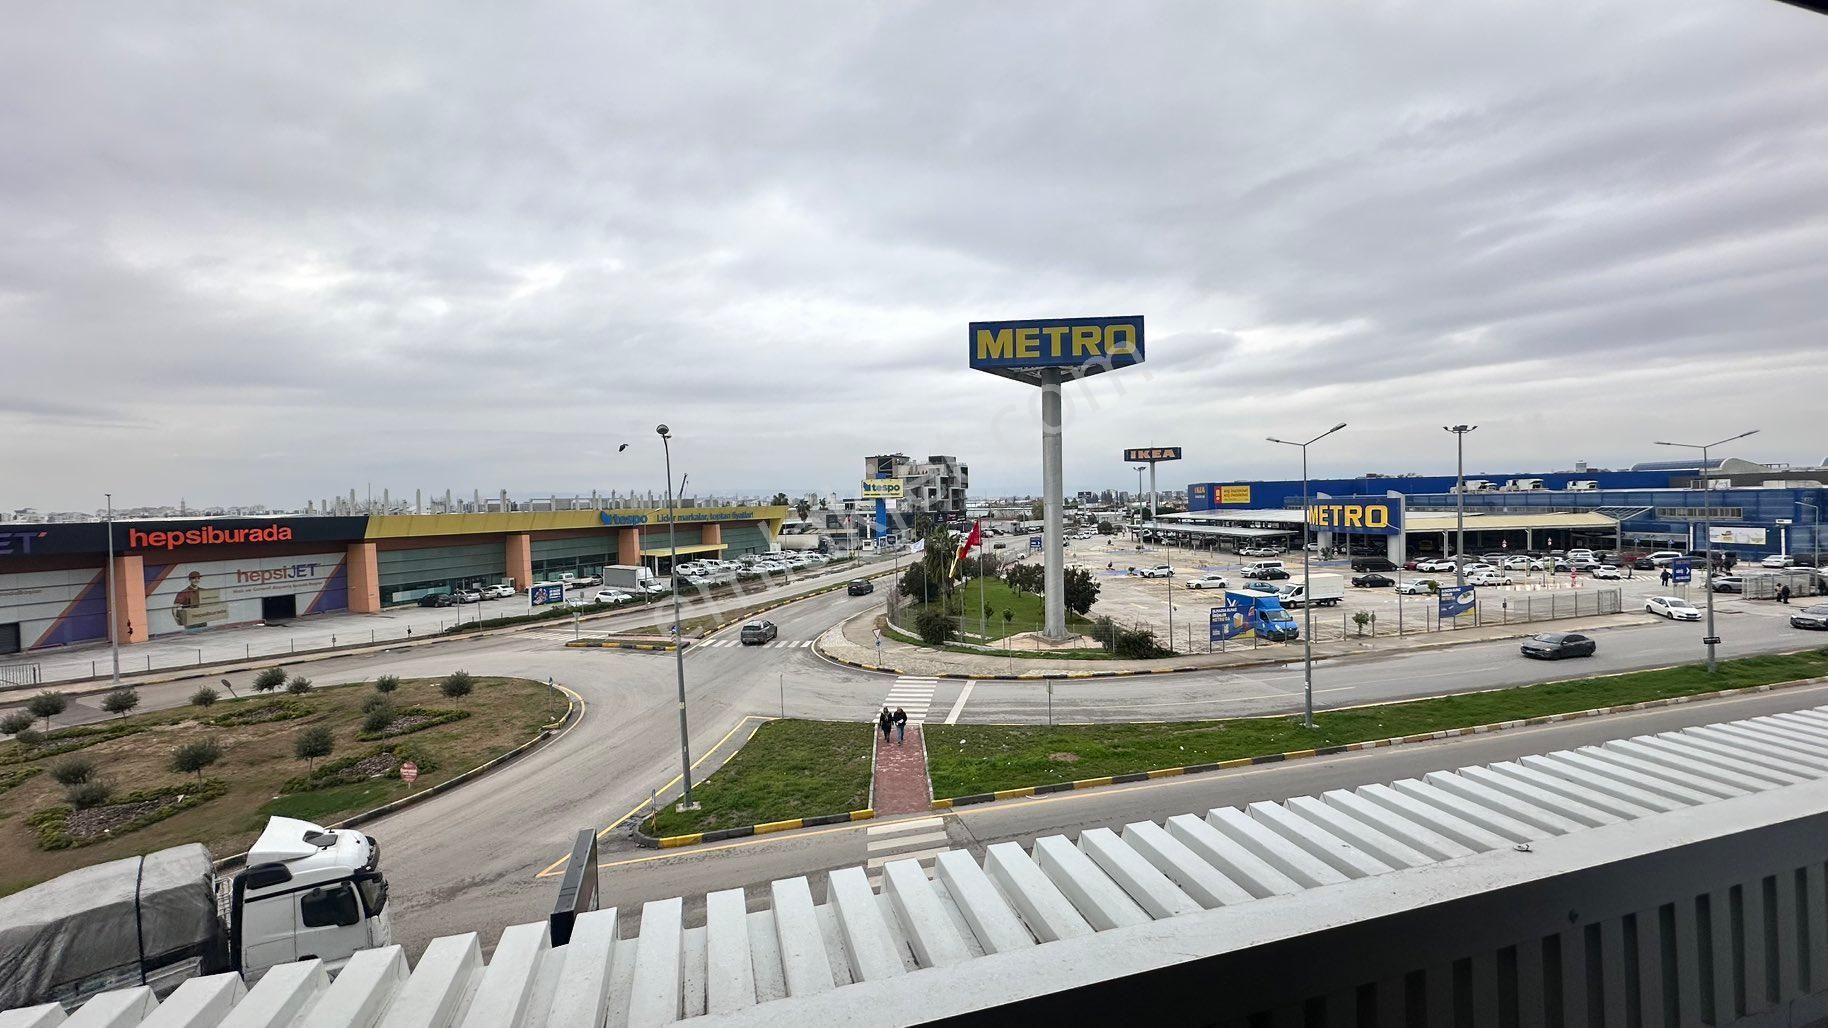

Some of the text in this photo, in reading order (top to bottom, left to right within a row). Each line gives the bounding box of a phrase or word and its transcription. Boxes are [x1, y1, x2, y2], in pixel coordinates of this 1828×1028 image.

[976, 324, 1136, 360] METRO
[1130, 448, 1177, 460] IKEA
[872, 484, 901, 493] tespo
[614, 513, 648, 526] tespo
[1308, 504, 1390, 529] METRO
[129, 524, 293, 550] hepsiburada
[236, 563, 319, 584] hepsiJET
